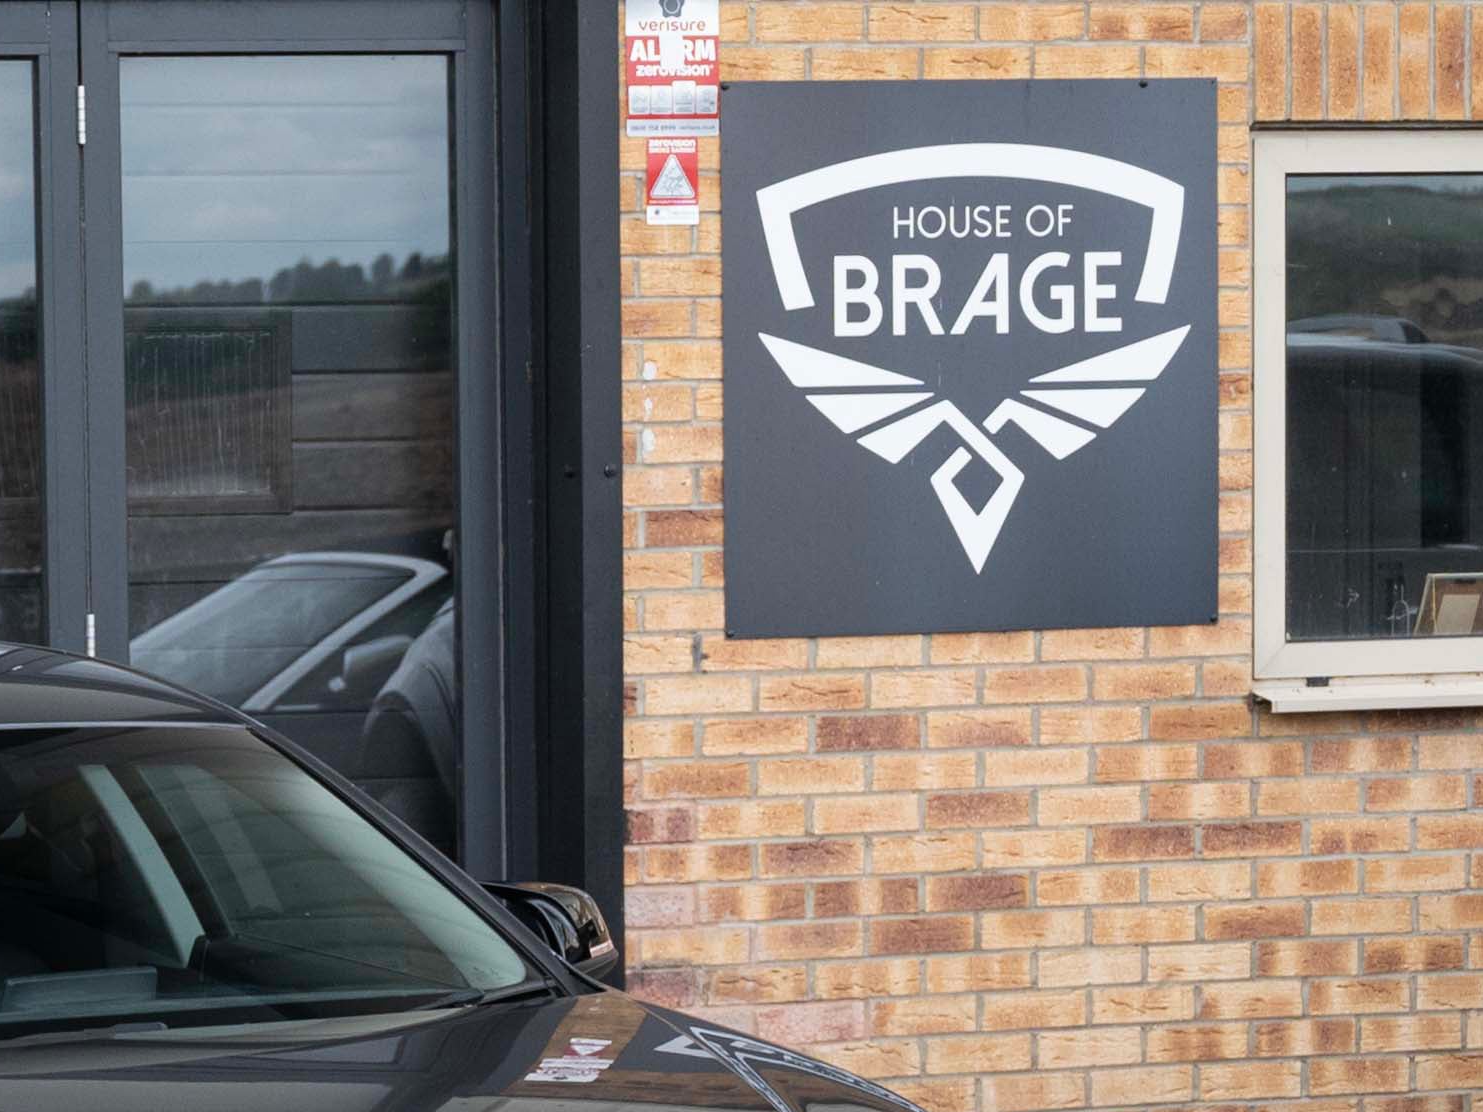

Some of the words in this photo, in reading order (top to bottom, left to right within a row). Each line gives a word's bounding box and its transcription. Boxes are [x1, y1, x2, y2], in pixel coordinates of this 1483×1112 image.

[638, 20, 706, 31] verisure
[629, 39, 716, 62] ALRM
[892, 205, 1012, 239] HOUSE
[1025, 204, 1075, 237] OF
[833, 251, 1123, 337] BRAGE
